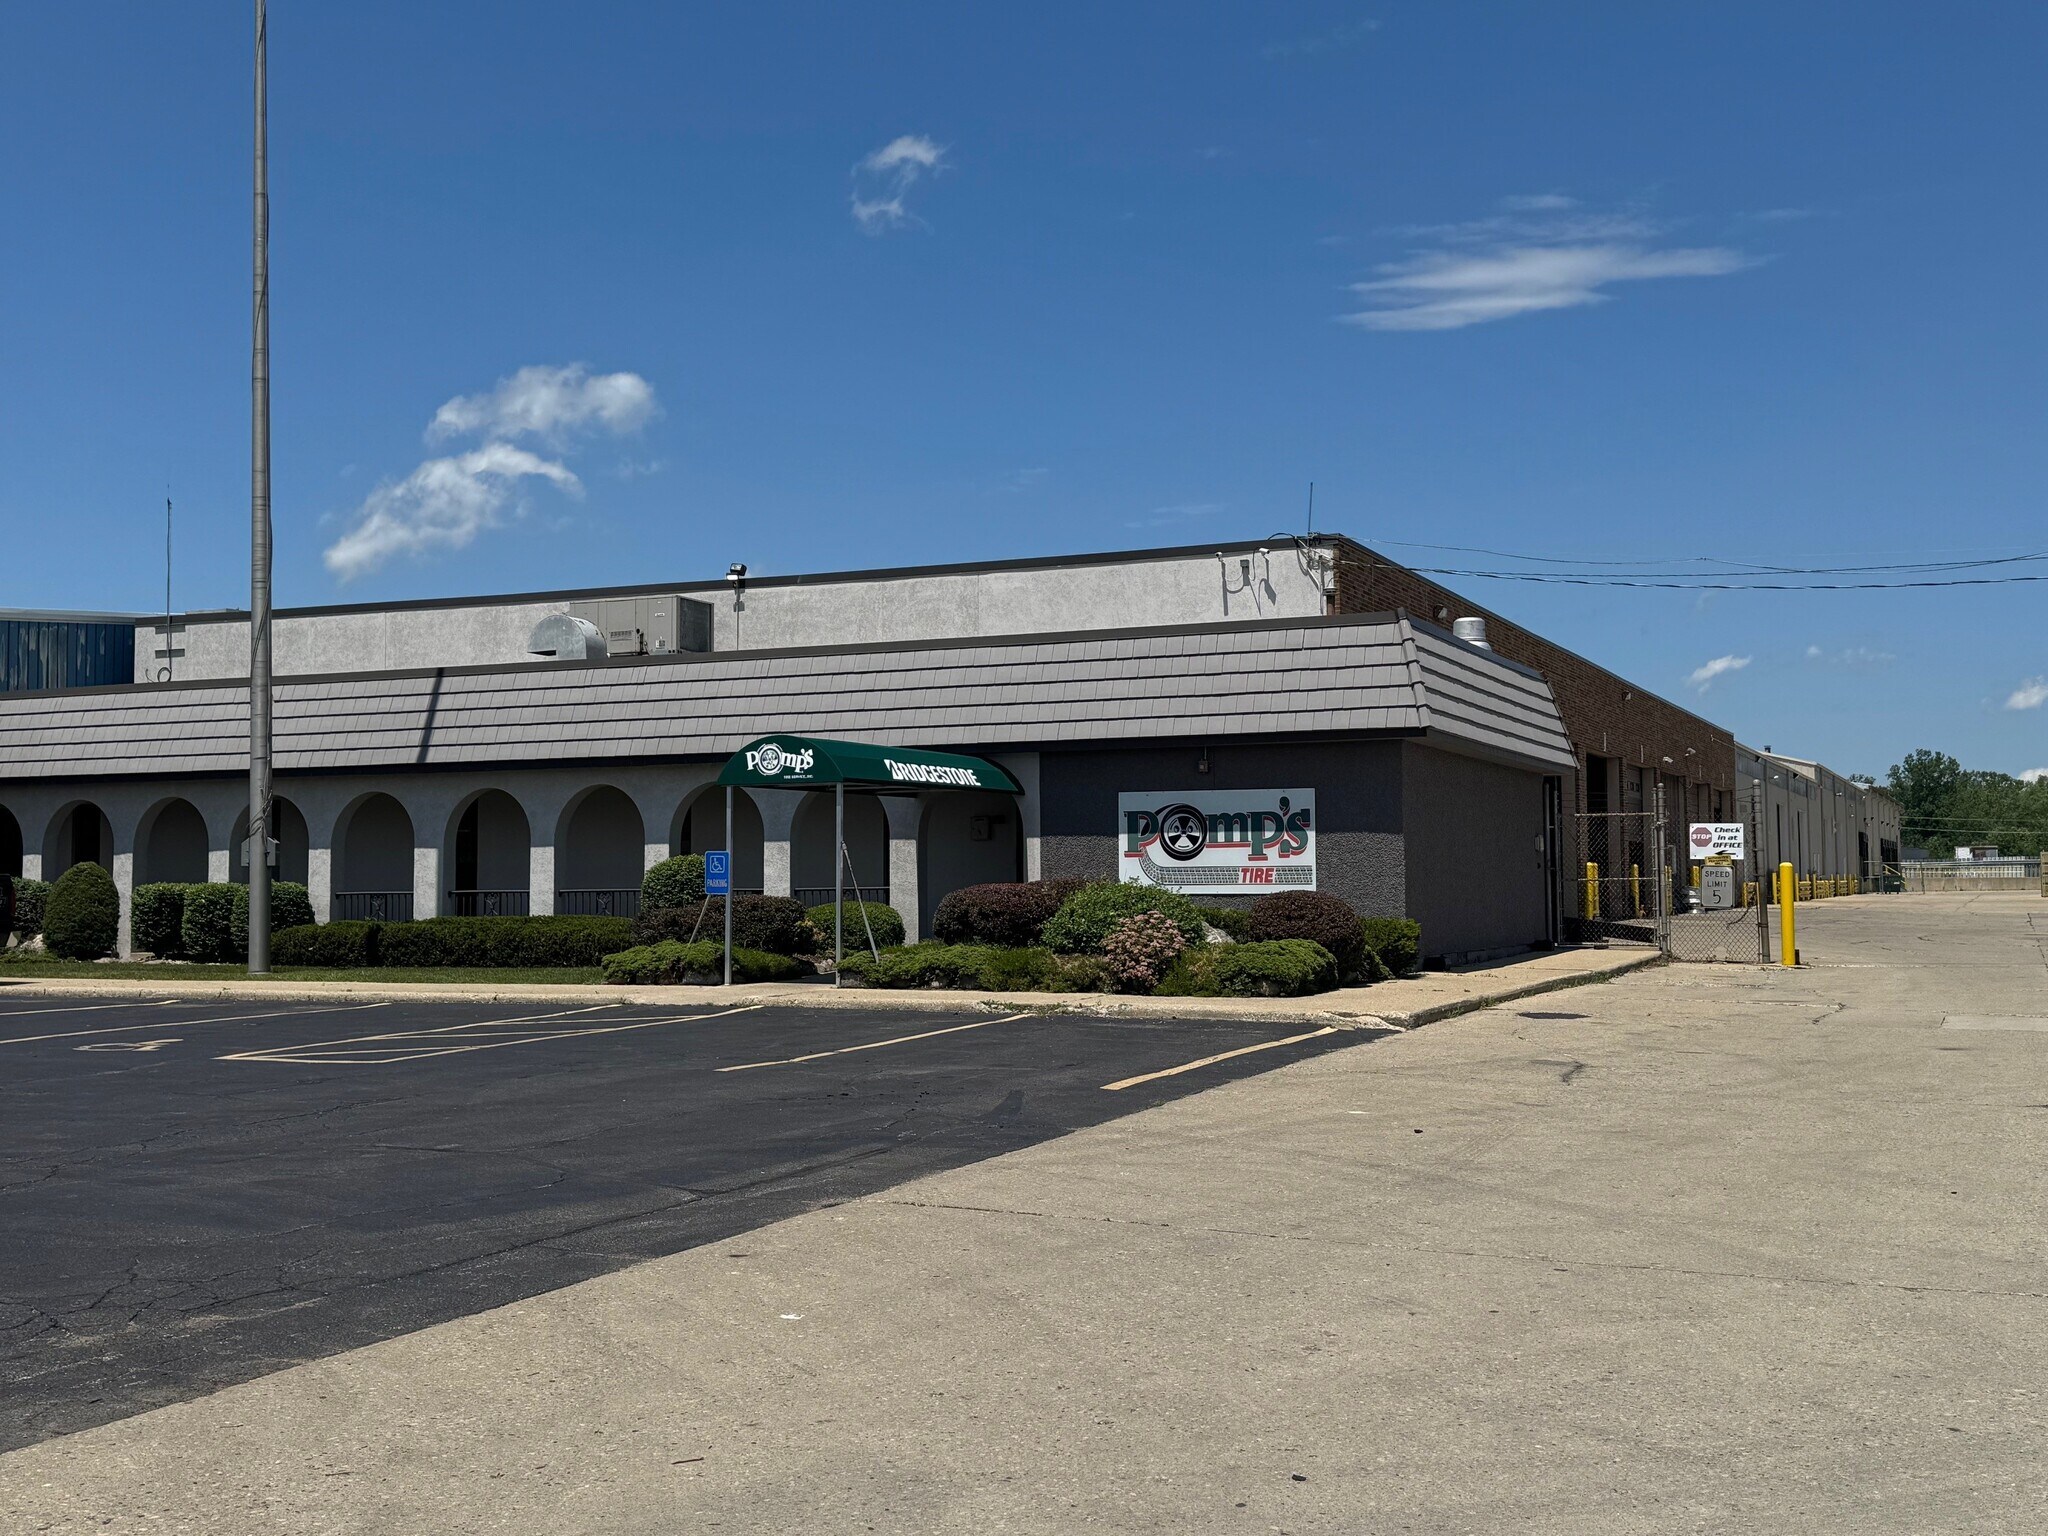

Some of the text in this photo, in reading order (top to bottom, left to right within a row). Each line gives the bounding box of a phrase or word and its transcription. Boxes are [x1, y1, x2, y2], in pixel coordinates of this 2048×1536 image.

[883, 759, 981, 786] BRIDGESTONE
[706, 878, 728, 888] PARKING
[1240, 867, 1275, 884] TIRE
[1712, 890, 1722, 904] 5
